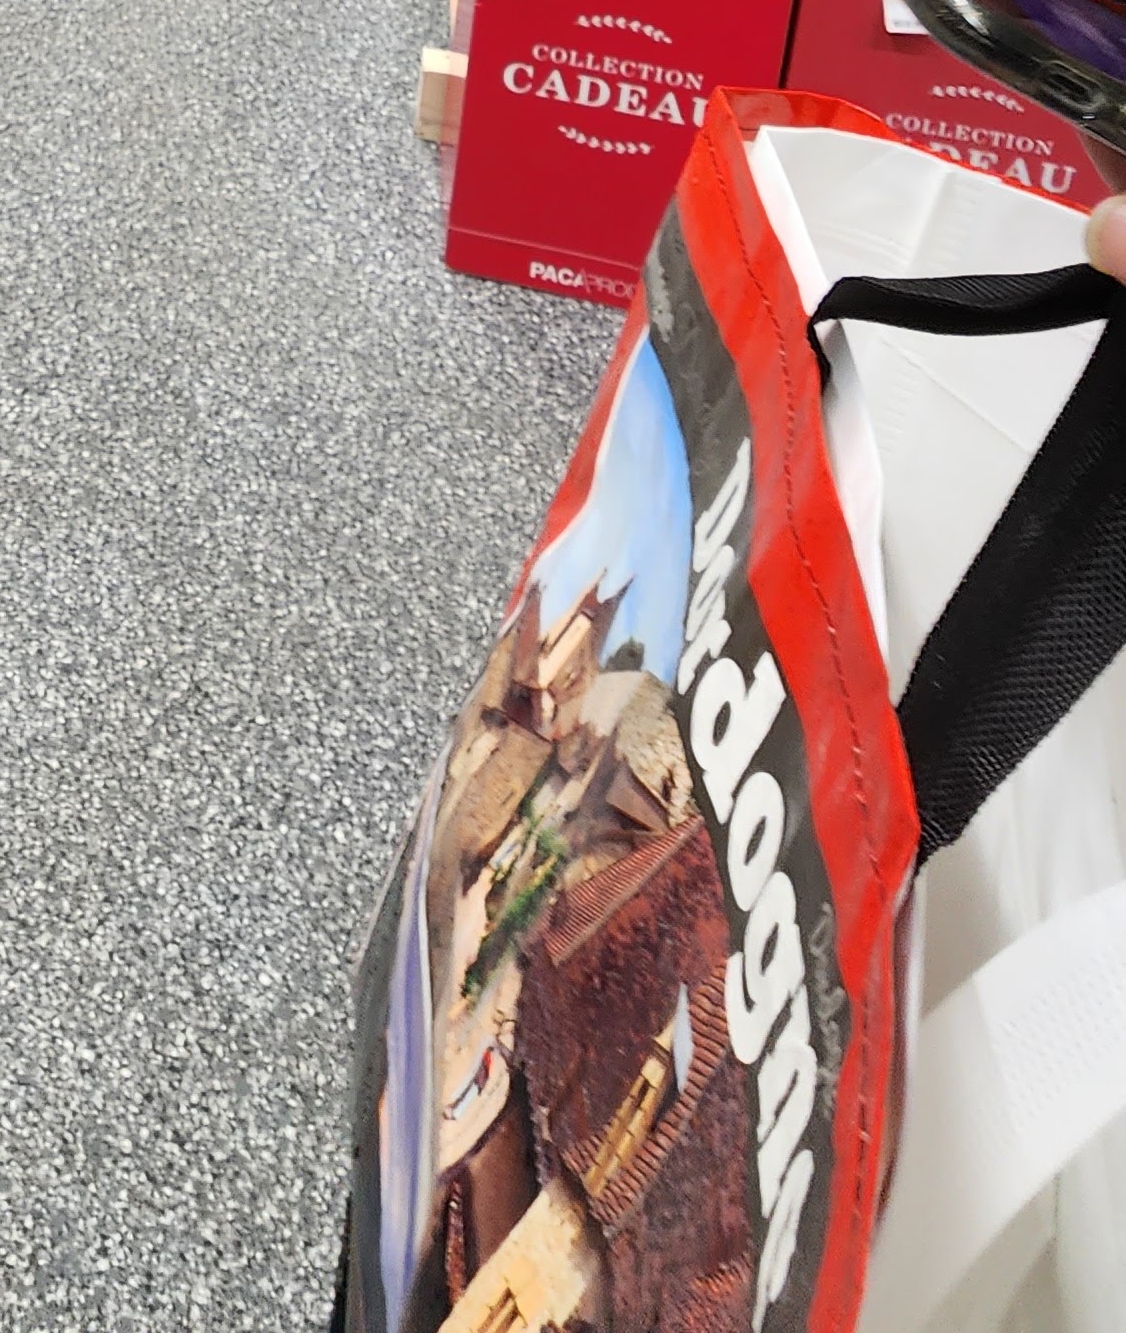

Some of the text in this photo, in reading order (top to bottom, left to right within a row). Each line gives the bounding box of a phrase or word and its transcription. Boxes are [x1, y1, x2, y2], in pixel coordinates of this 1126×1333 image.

[531, 42, 705, 91] COLLECTION
[884, 112, 1055, 156] COLLECTION
[679, 437, 815, 1331] Dordogne
